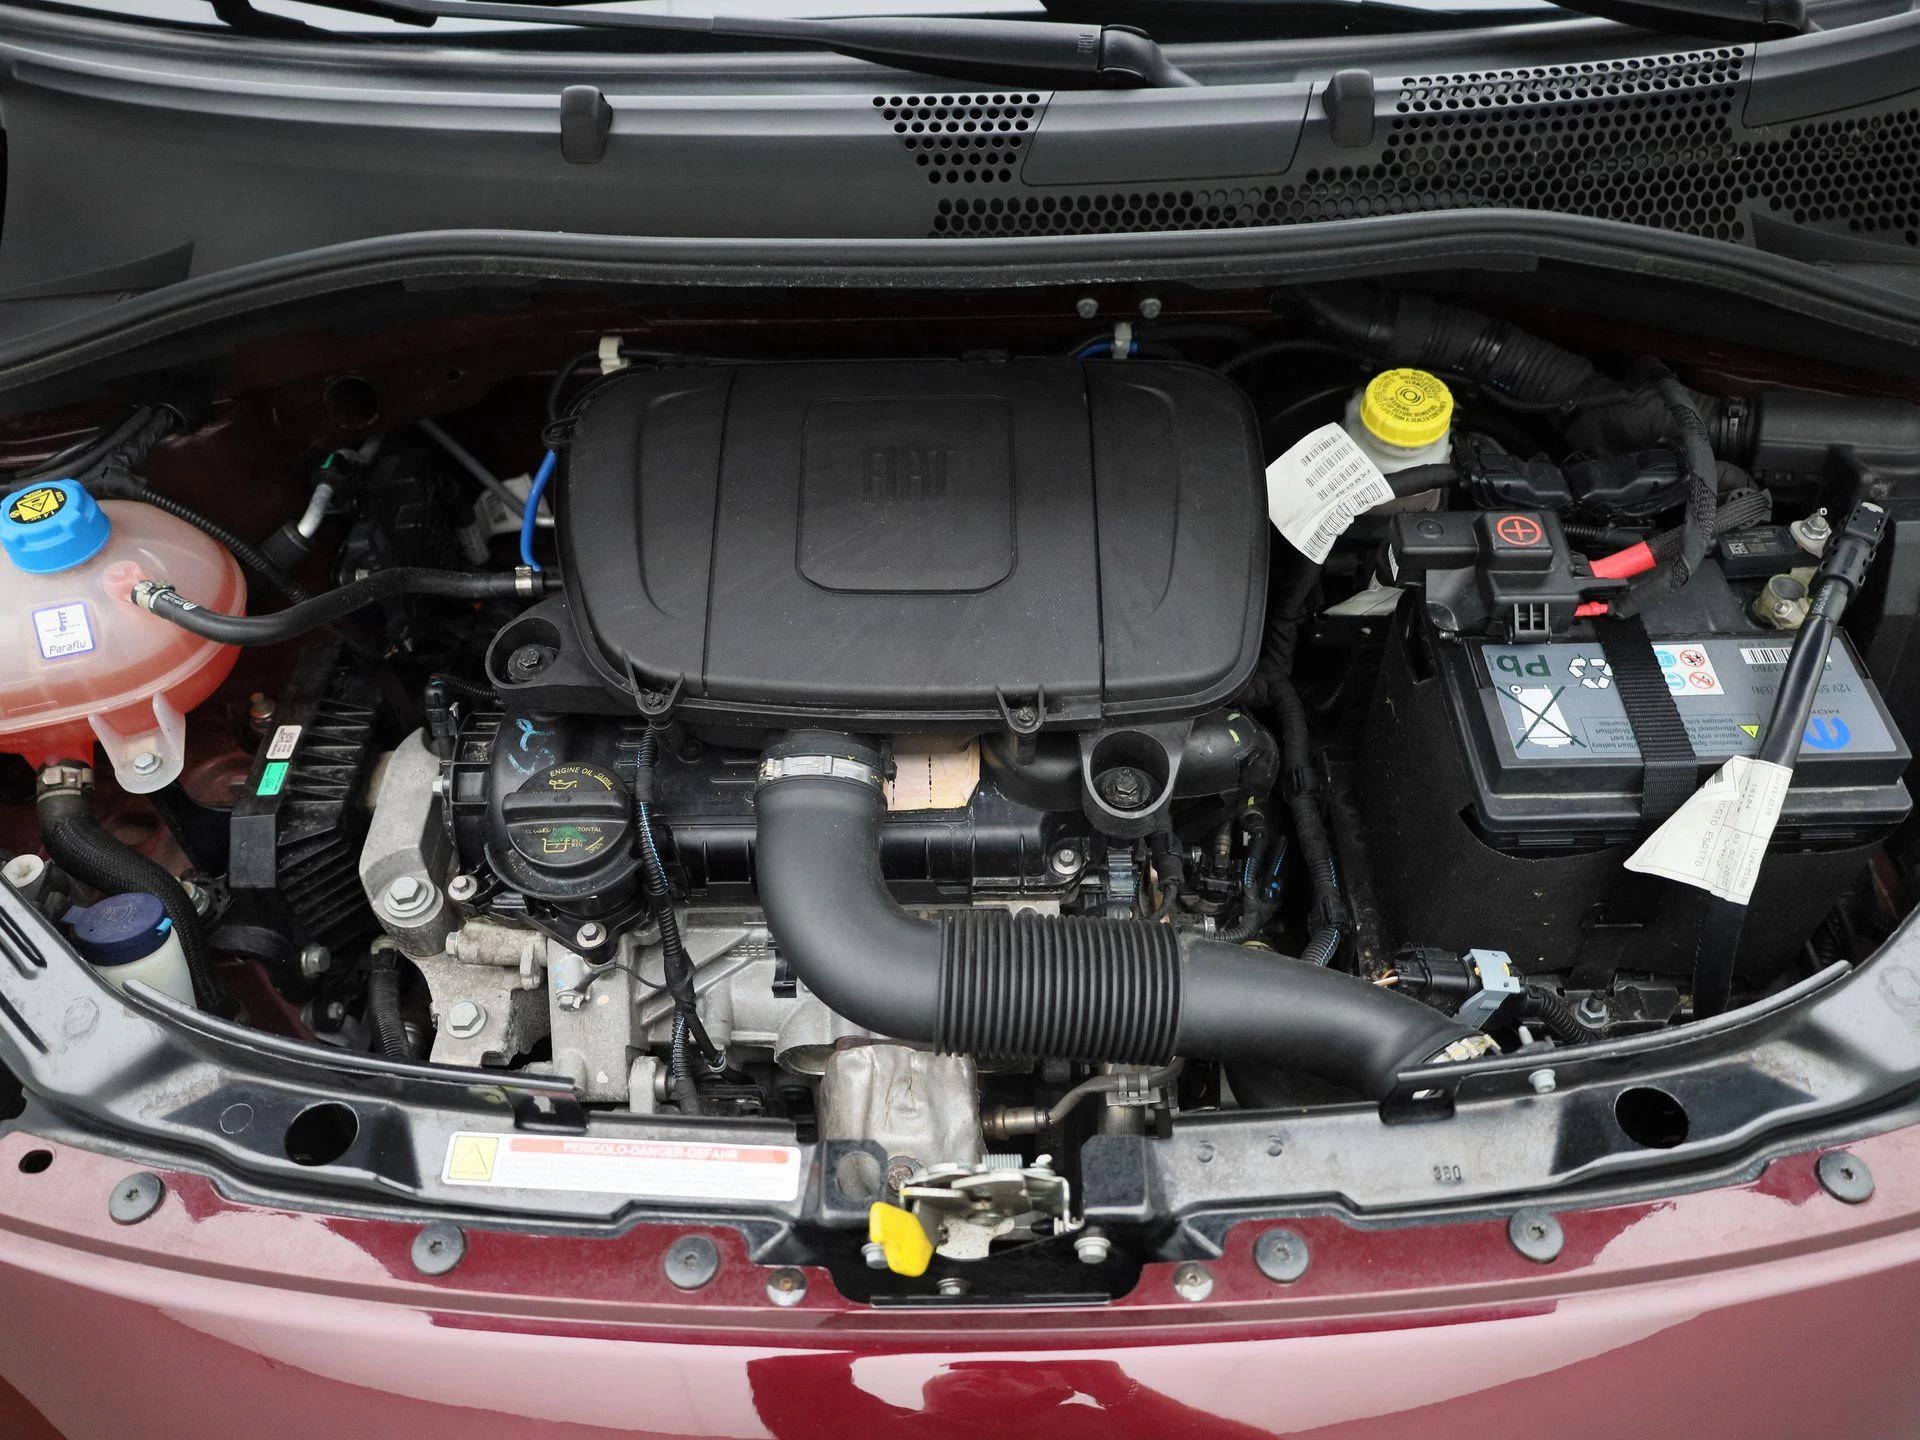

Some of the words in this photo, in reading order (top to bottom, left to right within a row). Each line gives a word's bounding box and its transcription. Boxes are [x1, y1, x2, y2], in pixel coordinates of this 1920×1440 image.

[862, 446, 955, 504] FIAT
[48, 637, 88, 657] Paraflu
[1496, 654, 1552, 677] Pb
[1832, 682, 1851, 693] 12V
[549, 766, 581, 777] ENGINE
[581, 767, 593, 777] OIL
[1694, 830, 1713, 867] ESATTO
